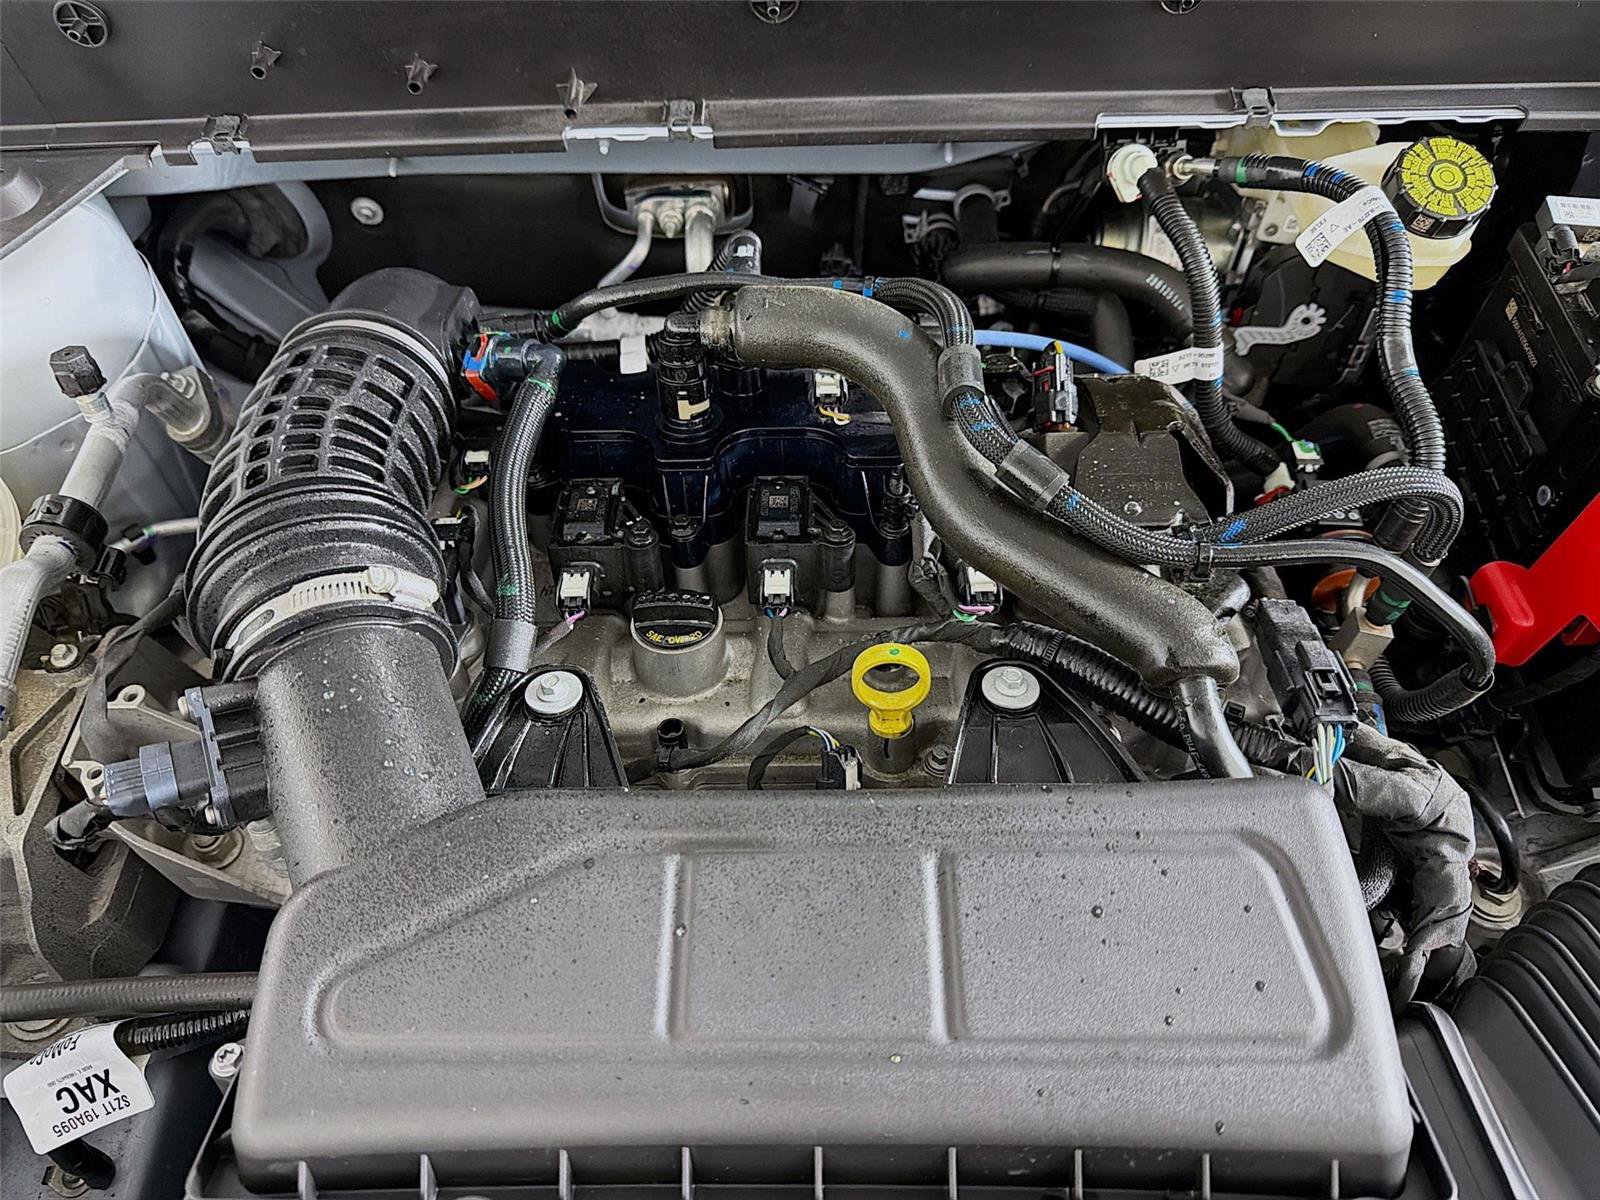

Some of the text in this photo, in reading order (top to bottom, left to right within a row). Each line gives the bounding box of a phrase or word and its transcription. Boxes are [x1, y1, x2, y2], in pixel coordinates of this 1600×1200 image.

[645, 630, 664, 643] SAE
[30, 1034, 82, 1066] FoMoCo
[56, 1068, 121, 1114] XAC
[52, 1094, 131, 1138] SZ1T 19A095
